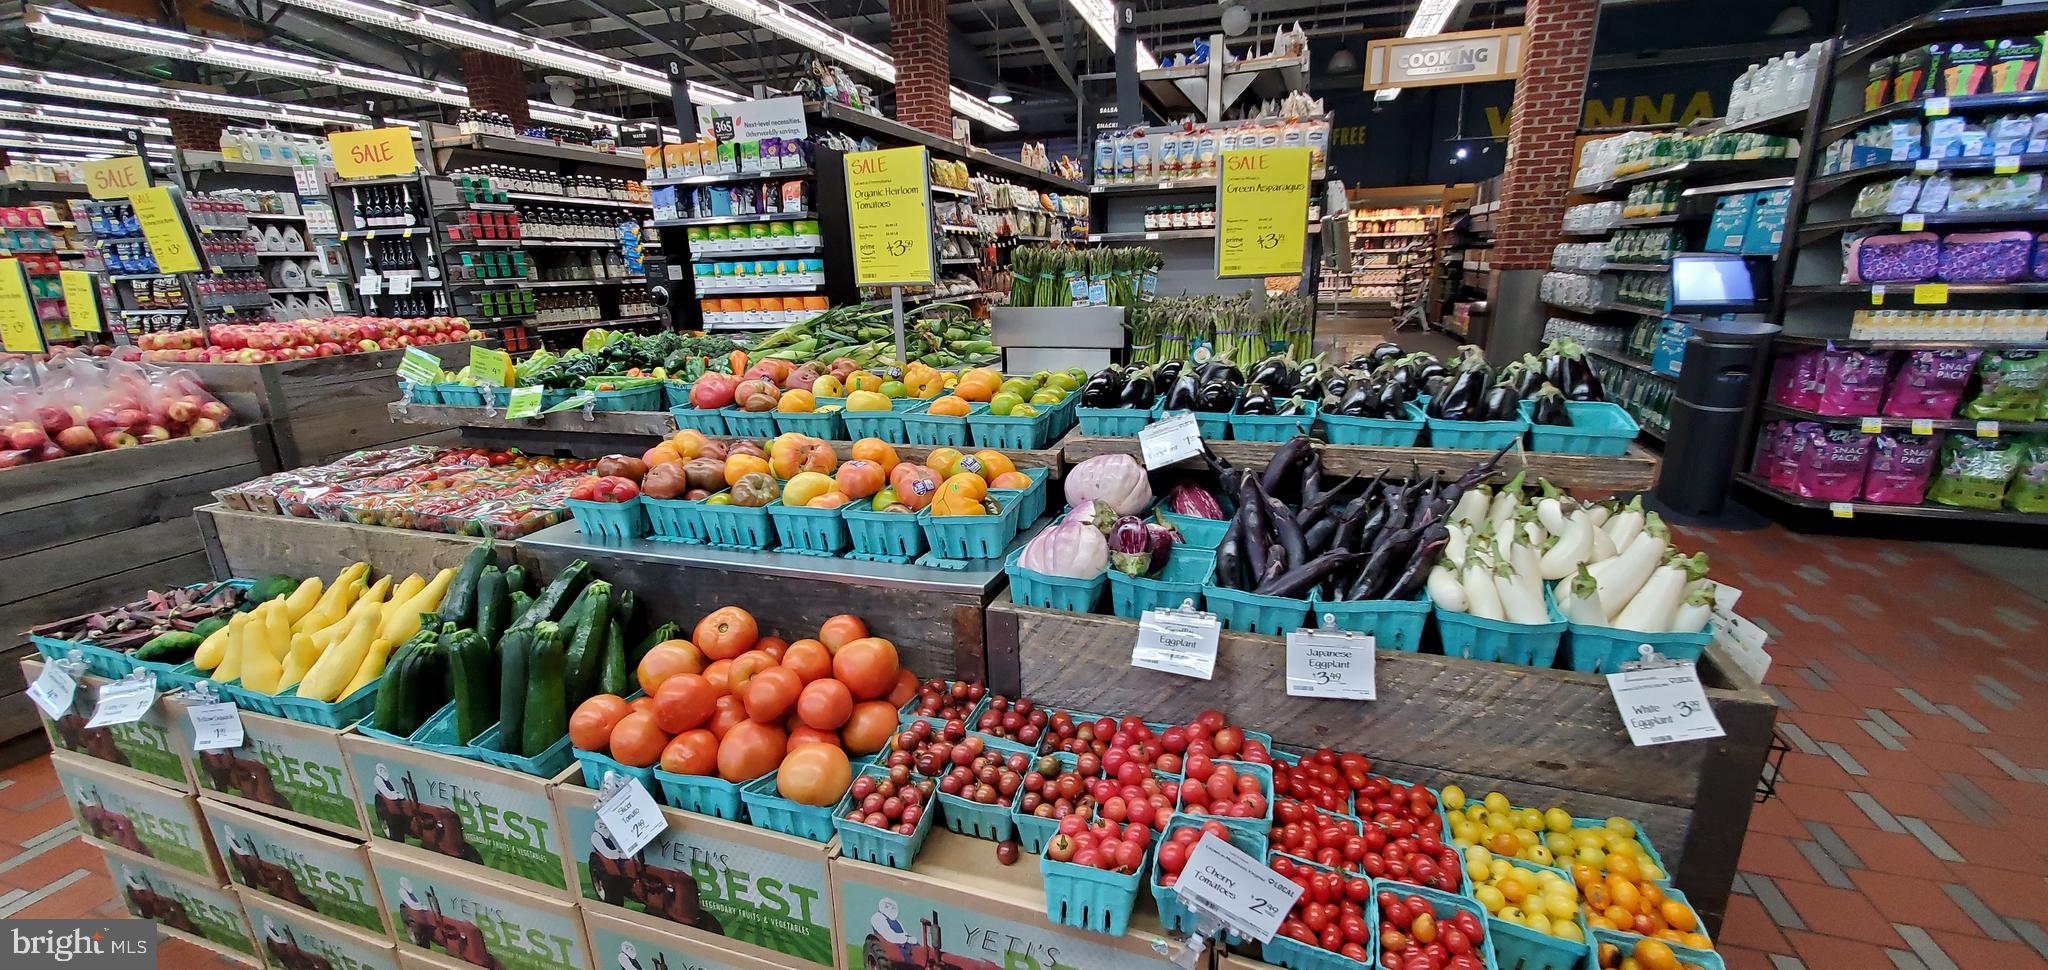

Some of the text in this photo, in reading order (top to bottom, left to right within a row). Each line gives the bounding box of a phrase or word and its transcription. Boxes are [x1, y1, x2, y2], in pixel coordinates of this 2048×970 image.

[1125, 7, 1133, 24] 9
[669, 61, 679, 75] 8
[366, 100, 375, 112] 7
[715, 120, 732, 134] 365
[744, 120, 771, 129] Next-level
[128, 130, 137, 140] 6
[351, 140, 393, 164] SALE
[851, 156, 888, 175] SALE
[1227, 154, 1271, 171] SALE
[95, 166, 137, 190] SALE
[854, 186, 919, 200] Organic Heirloom
[1226, 182, 1305, 194] Green Asparagus
[856, 200, 891, 210] Tomatoes
[1831, 453, 1861, 462] PACK
[1832, 446, 1865, 455] SNAC
[1160, 635, 1197, 649] Eggplant
[1306, 648, 1352, 658] Japanese
[1308, 659, 1350, 670] Eggplant
[1632, 704, 1661, 715] White
[1630, 716, 1674, 730] Eggplant
[261, 750, 342, 797] BEST
[426, 779, 481, 808] YETI'S
[452, 796, 549, 852] BEST
[622, 807, 640, 824] Tomato
[126, 806, 189, 847] BEST
[659, 838, 729, 875] YETI'S
[284, 857, 364, 903] BEST
[1194, 870, 1237, 900] Tomatoes
[1205, 865, 1236, 888] Cherry
[690, 859, 819, 925] BEST
[1273, 880, 1295, 898] LOCAL
[450, 896, 504, 925] YETI'S
[702, 899, 810, 936] LEGENDARY FRUITS & VEGETABLES
[475, 912, 574, 967] BEST
[963, 922, 1061, 967] YETI'S
